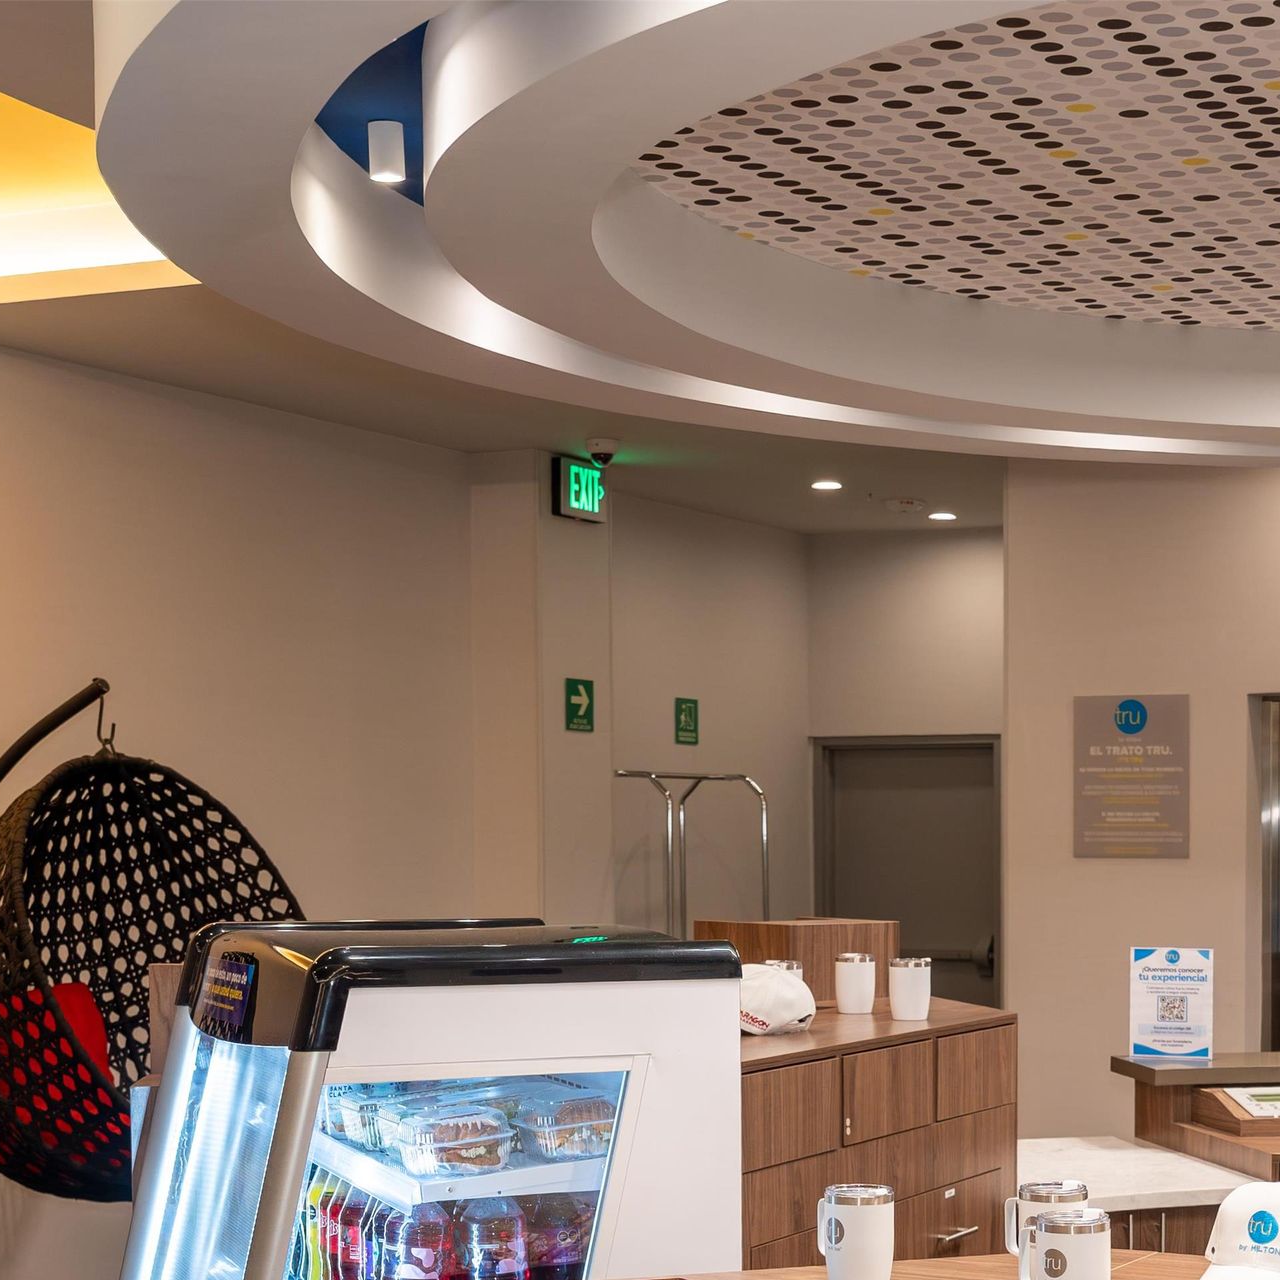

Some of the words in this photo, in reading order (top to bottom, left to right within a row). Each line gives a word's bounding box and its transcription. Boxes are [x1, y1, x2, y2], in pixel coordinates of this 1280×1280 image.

[570, 464, 601, 514] EXIT
[1116, 706, 1141, 725] tru
[1090, 746, 1103, 756] EL
[1107, 746, 1144, 756] TRATO
[1147, 745, 1173, 756] TRU.
[1139, 973, 1149, 981] tu
[1151, 973, 1208, 983] experiencia!
[1249, 1217, 1273, 1236] tru
[1238, 1244, 1248, 1252] by
[1250, 1245, 1280, 1256] HILTON
